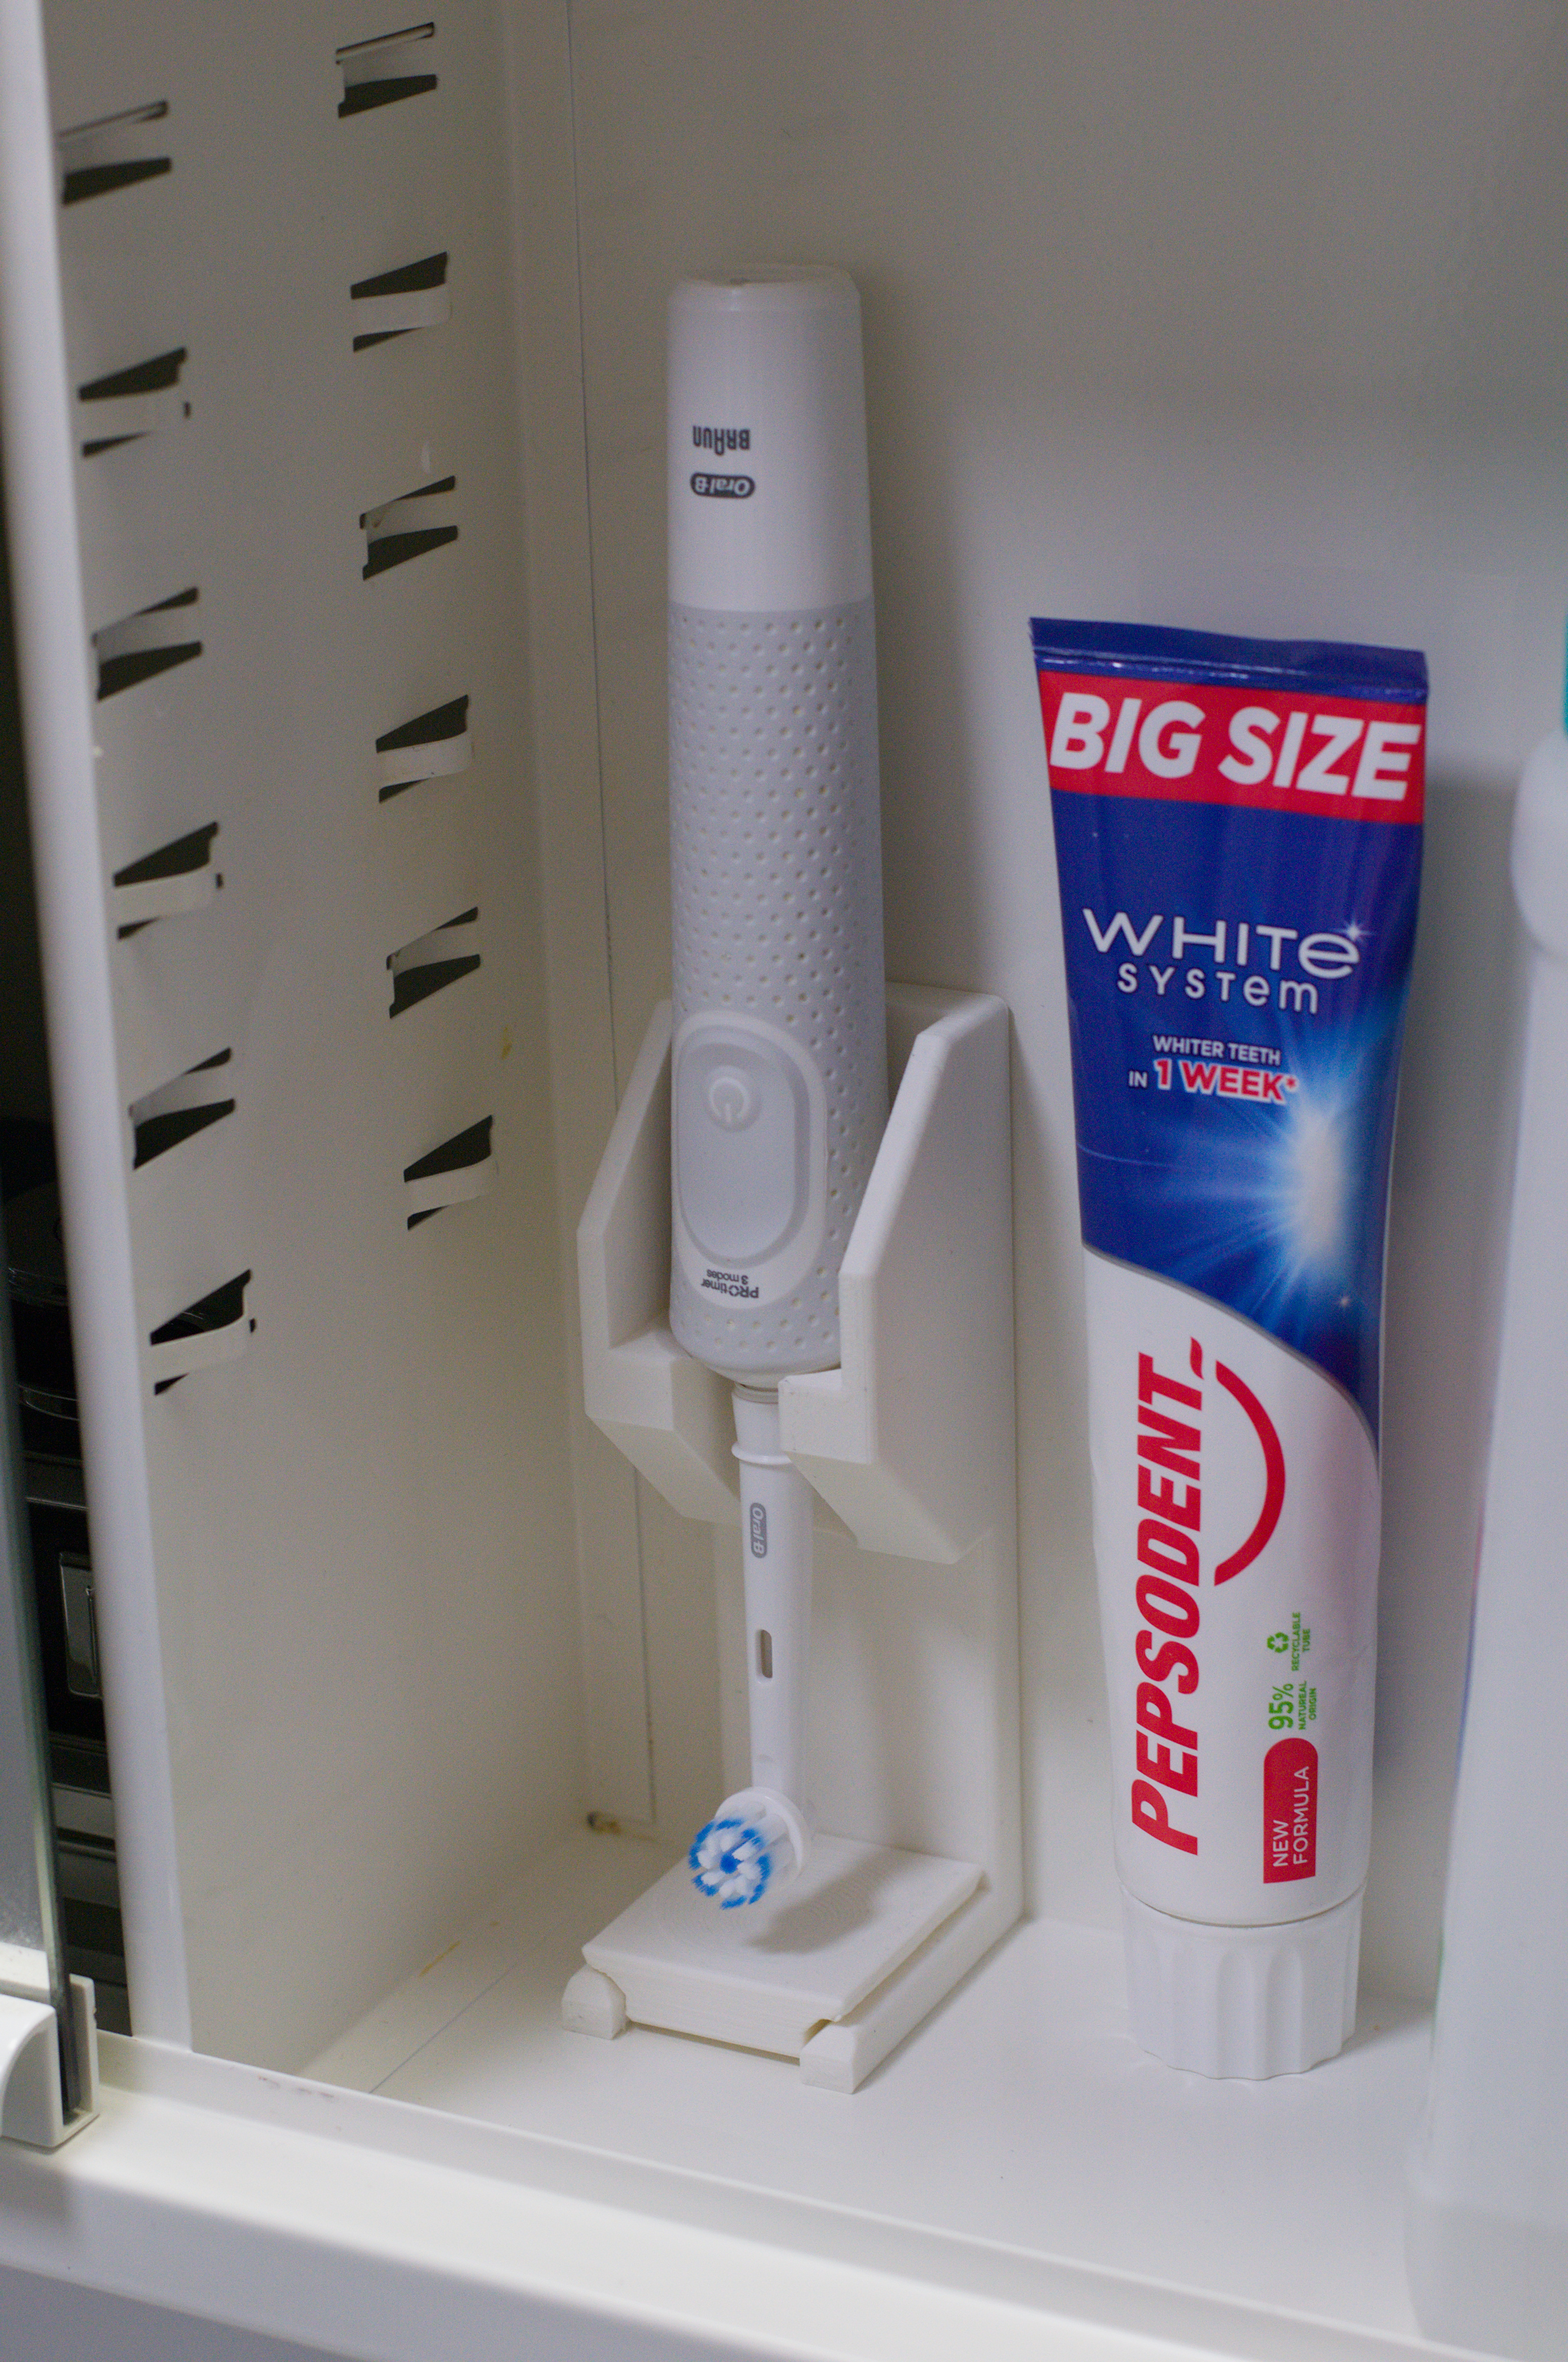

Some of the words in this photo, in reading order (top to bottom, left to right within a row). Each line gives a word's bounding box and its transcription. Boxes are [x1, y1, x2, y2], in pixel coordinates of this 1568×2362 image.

[693, 426, 750, 455] BRAUN
[1050, 692, 1206, 778] BIG
[1218, 706, 1421, 800] SIZE
[1153, 1035, 1223, 1059] WHITER
[1229, 1043, 1280, 1065] TEETH
[1128, 1071, 1147, 1088] IN
[1154, 1059, 1172, 1090] 1
[707, 1269, 739, 1281] modes
[742, 1275, 748, 1284] 3
[1131, 1352, 1203, 1856] PEPSODENT
[1292, 1612, 1300, 1671] RECYCLABLE
[1302, 1629, 1310, 1652] TUBE
[1268, 1683, 1294, 1730] 95%
[1309, 1688, 1317, 1720] ORIGIN
[1293, 1766, 1310, 1865] FORMULA
[1272, 1820, 1289, 1867] NEW
